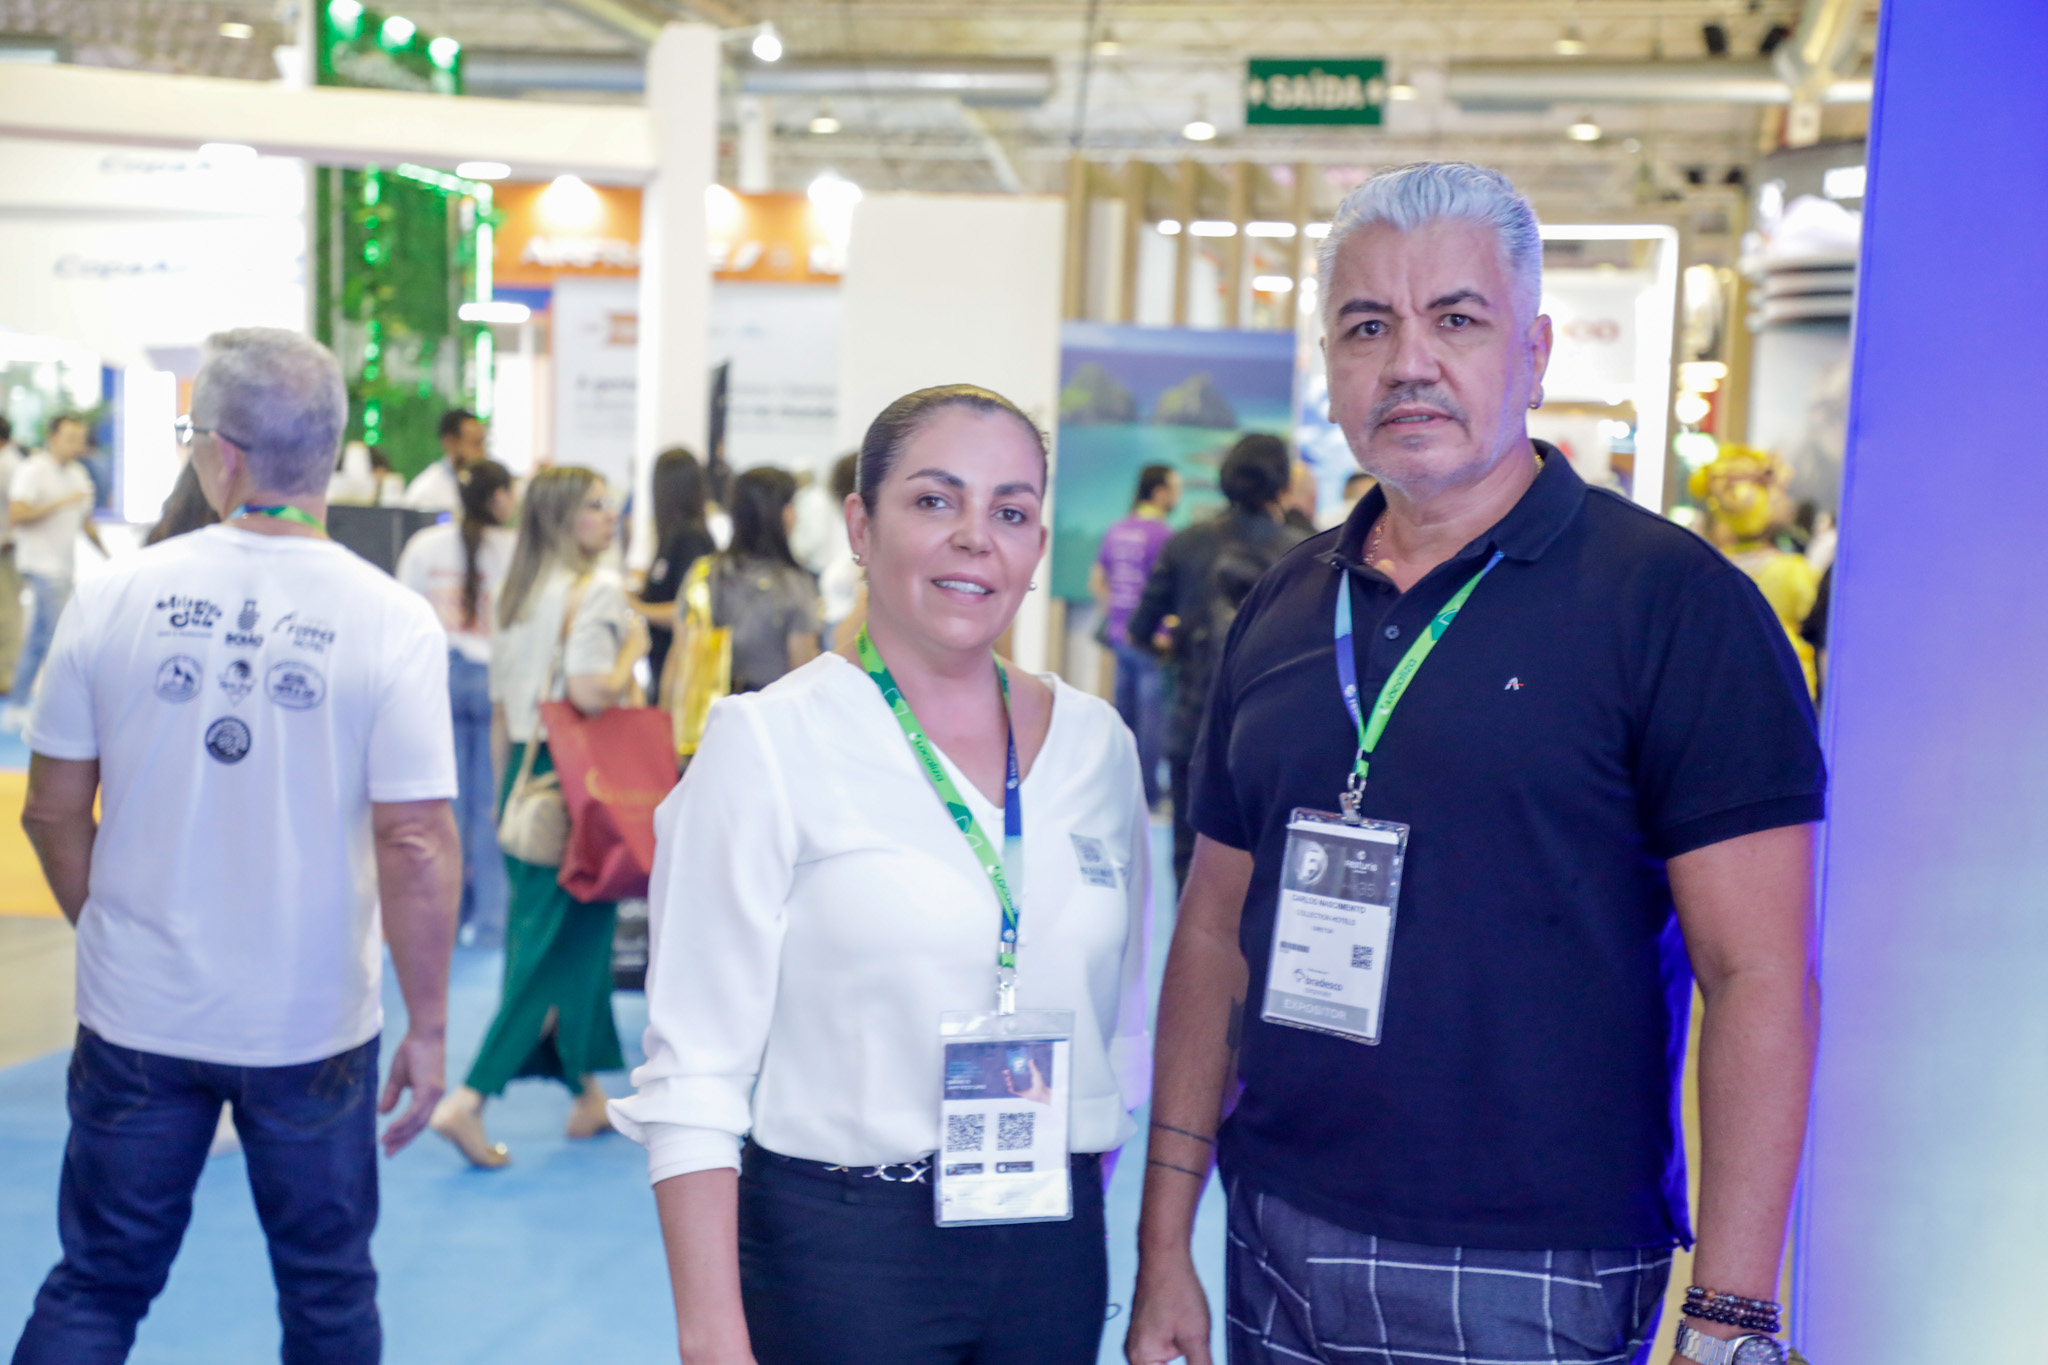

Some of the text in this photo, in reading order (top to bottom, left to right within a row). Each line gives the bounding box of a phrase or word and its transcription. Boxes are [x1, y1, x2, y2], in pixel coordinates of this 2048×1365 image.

[1265, 67, 1366, 111] SAÍDA
[1384, 658, 1418, 707] Localiza
[914, 740, 945, 783] Localiza
[1292, 894, 1366, 914] CARLOS NASCIMENTO
[1305, 976, 1344, 992] bradesco
[1283, 999, 1347, 1021] EXPOSITOR
